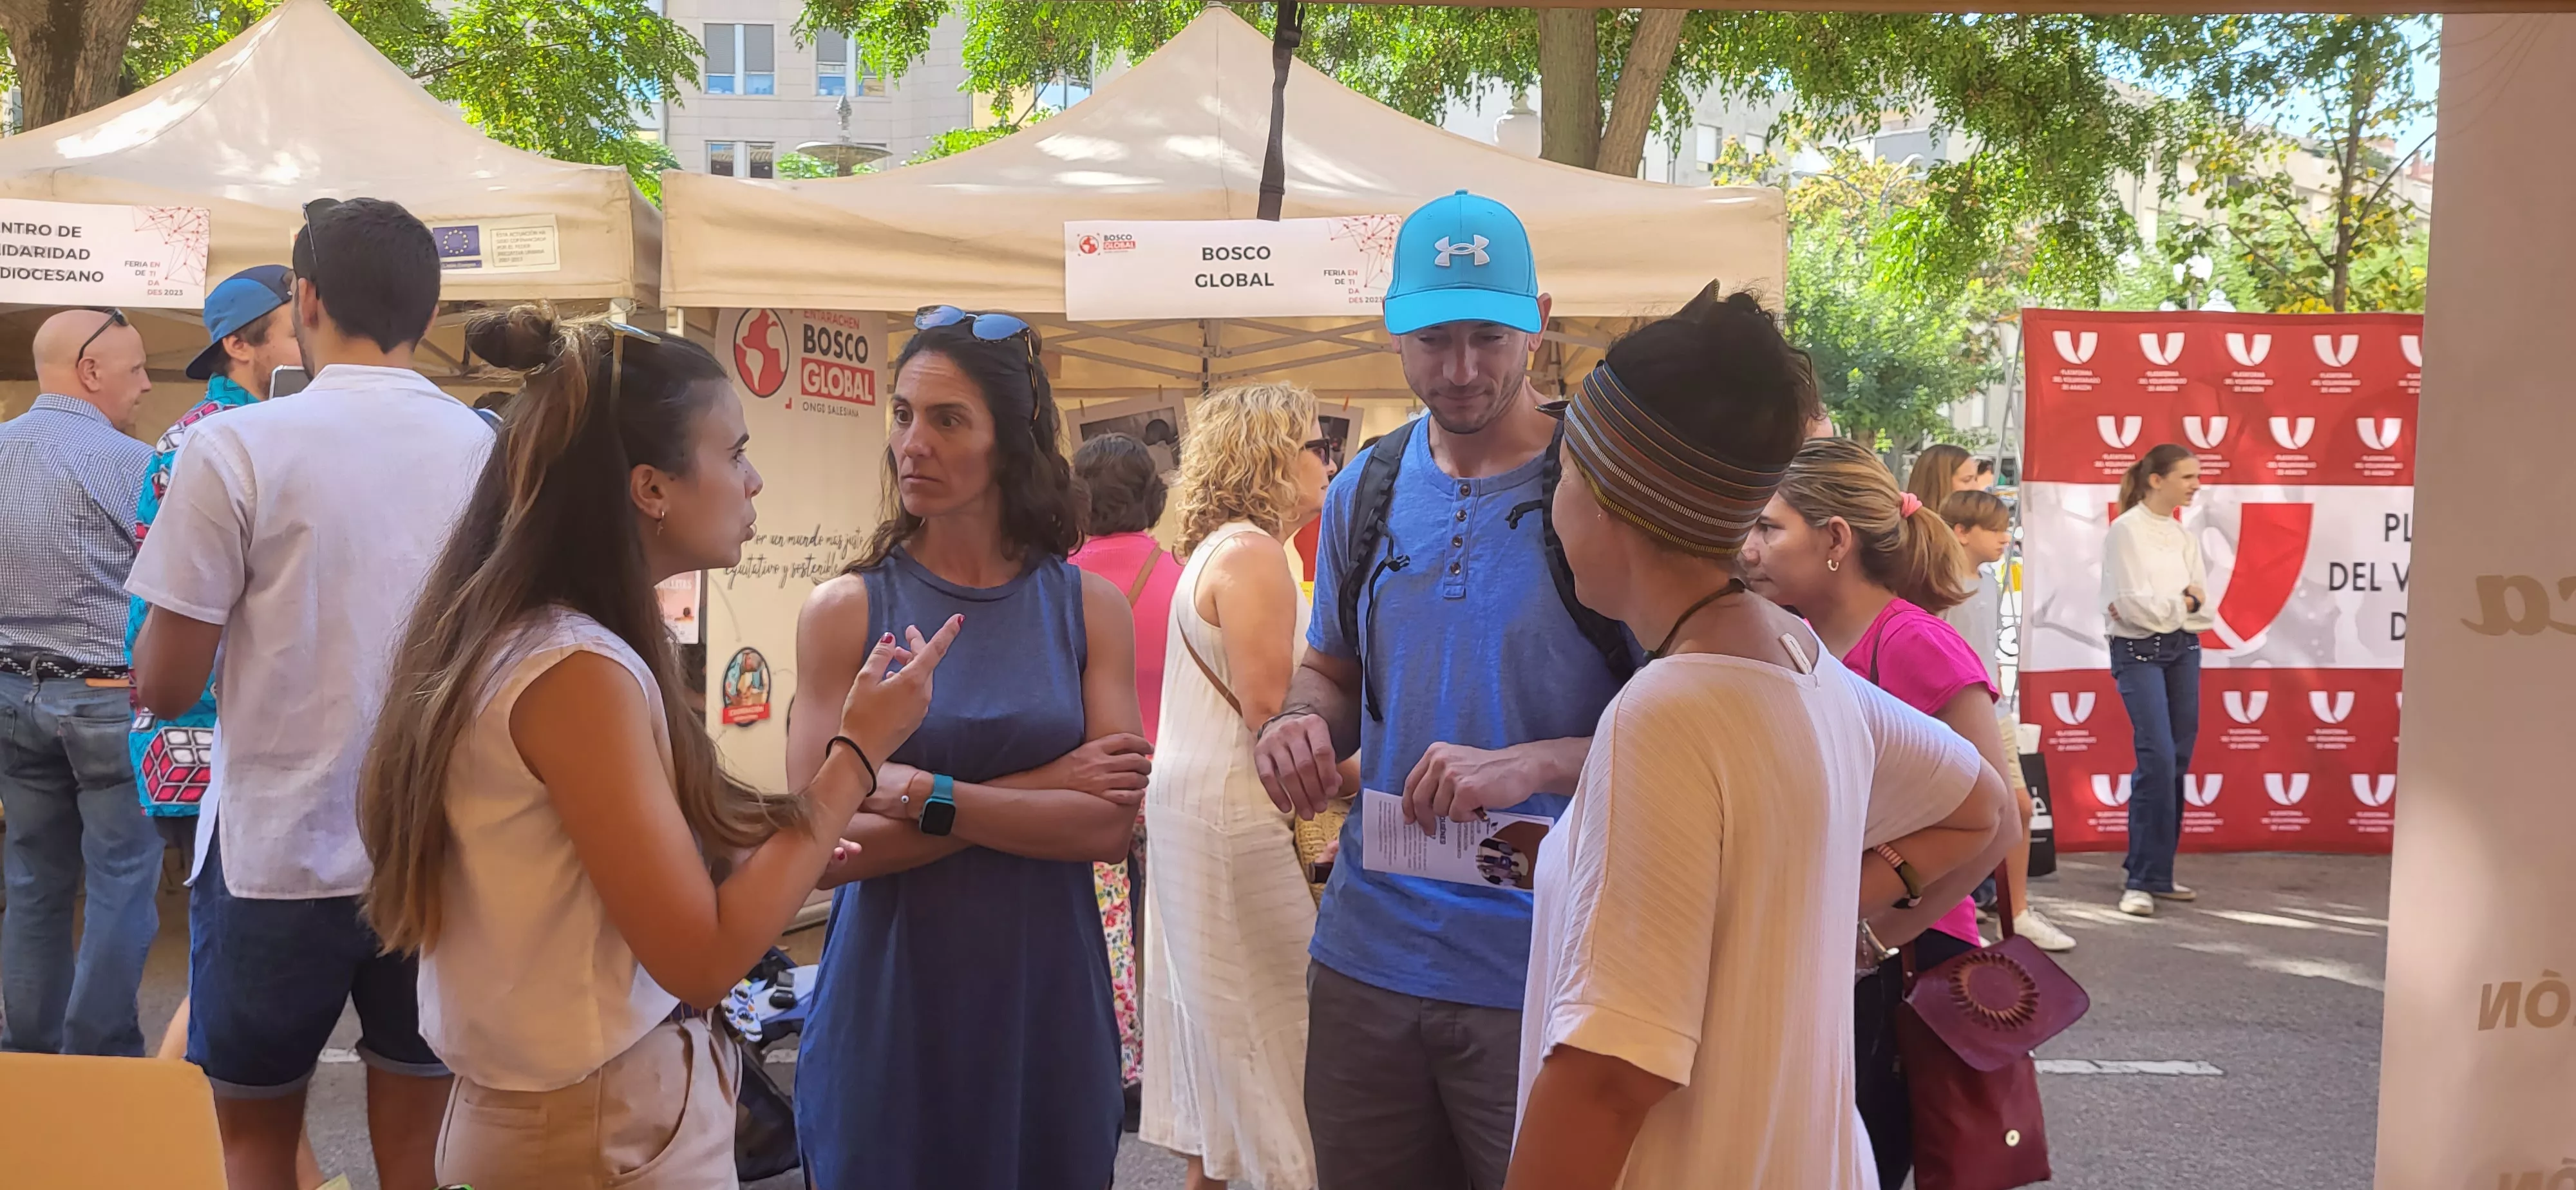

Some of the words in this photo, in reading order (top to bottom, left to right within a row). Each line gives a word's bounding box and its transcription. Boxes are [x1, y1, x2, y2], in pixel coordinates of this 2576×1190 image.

[0, 222, 52, 236] NTRO
[58, 225, 82, 238] DE
[0, 244, 91, 260] IDARIDAD
[1104, 241, 1135, 250] GLOBAL
[1202, 245, 1271, 261] BOSCO
[0, 267, 104, 282] DIOCESANO
[1195, 272, 1274, 288] GLOBAL
[803, 323, 869, 364] BOSCO
[803, 362, 873, 402] GLOBAL
[802, 401, 826, 414] ONGD
[828, 404, 860, 419] SALESIANA
[2329, 562, 2382, 591] DEL
